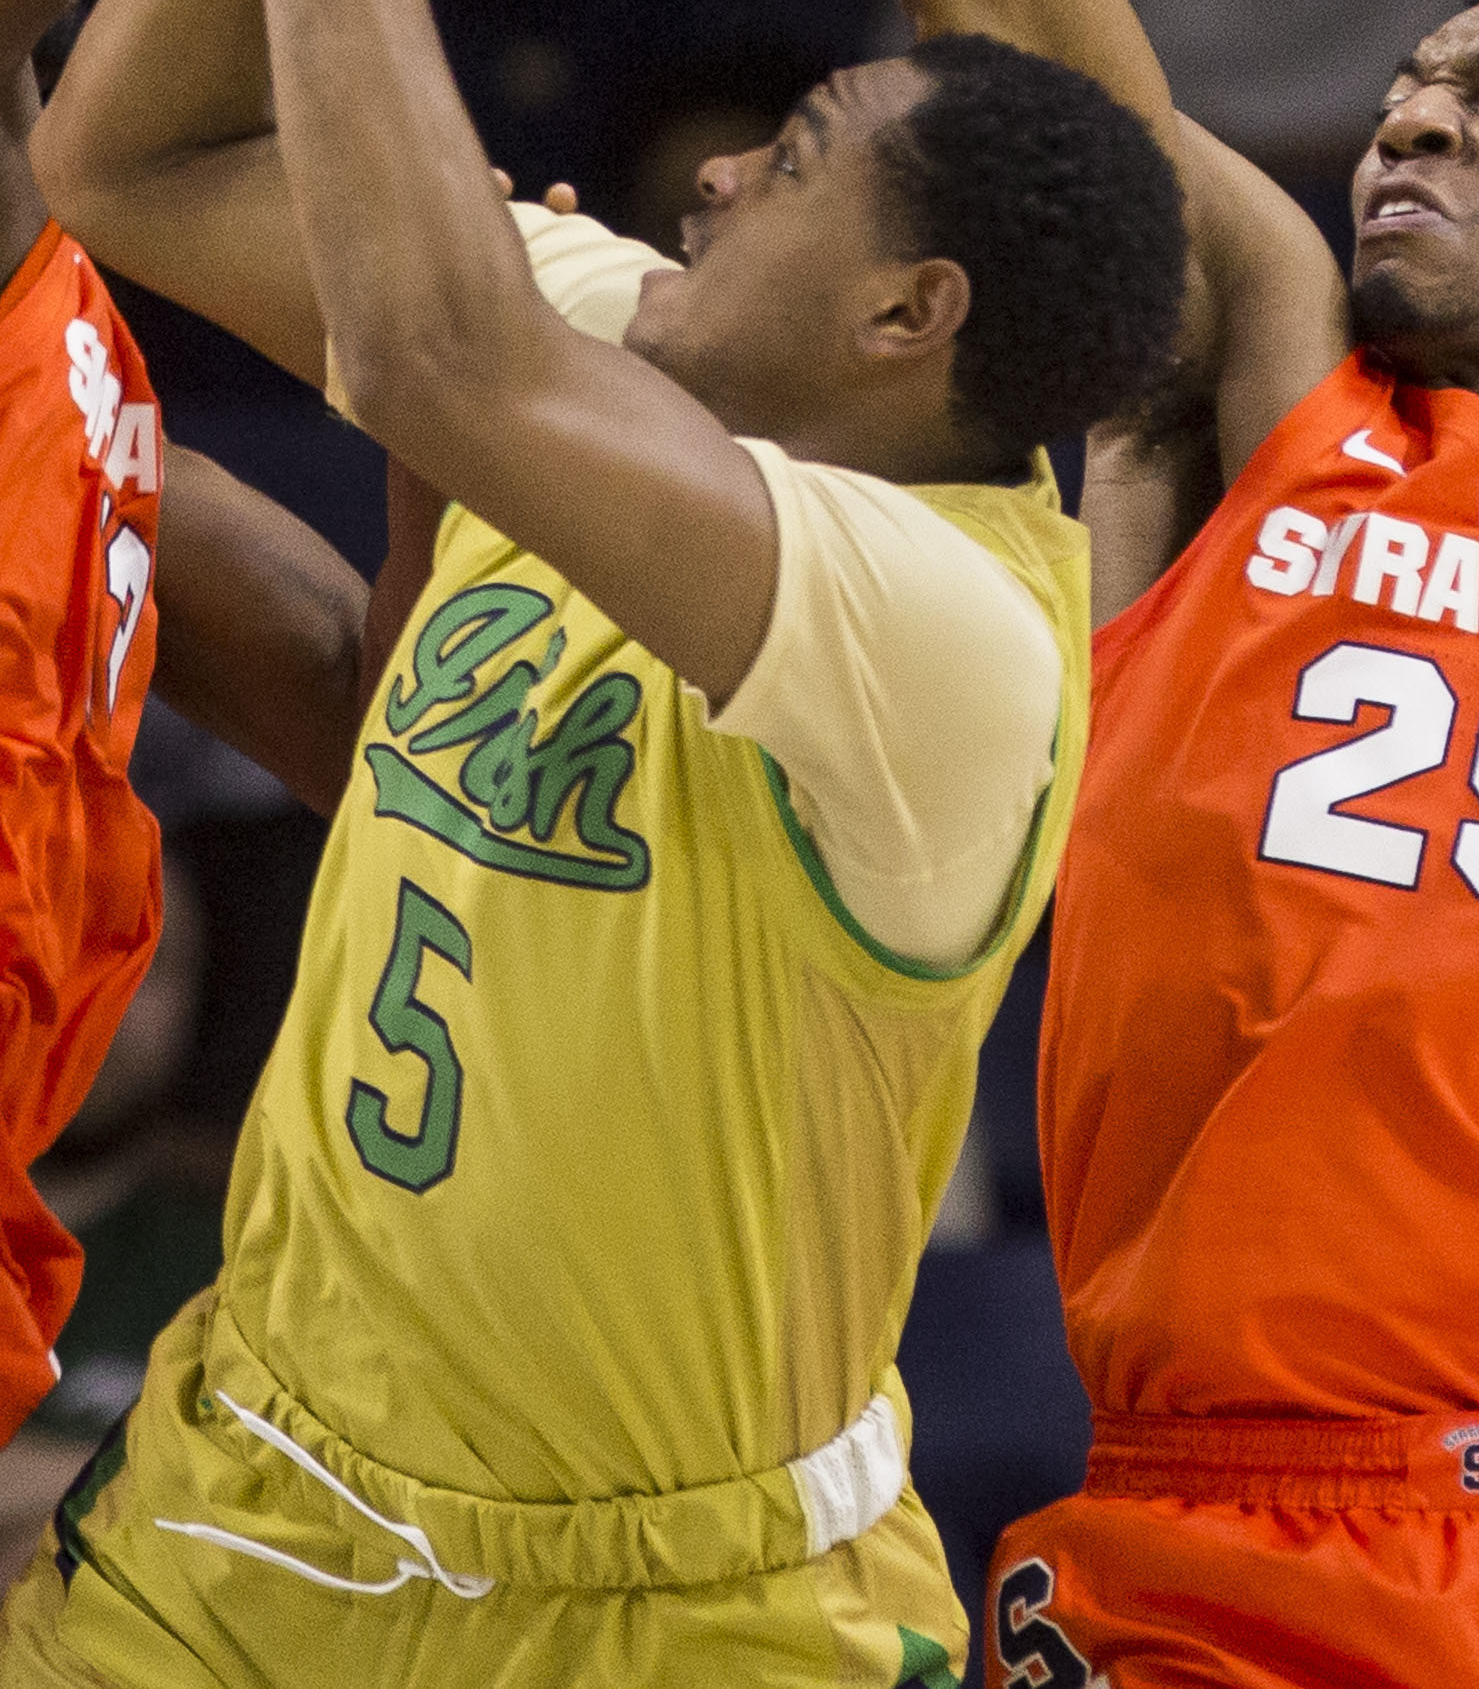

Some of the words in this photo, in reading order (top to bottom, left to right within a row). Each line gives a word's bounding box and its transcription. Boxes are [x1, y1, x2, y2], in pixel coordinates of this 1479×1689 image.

[366, 582, 651, 893] Irsh
[345, 876, 473, 1194] 5
[996, 1557, 1092, 1689] S
